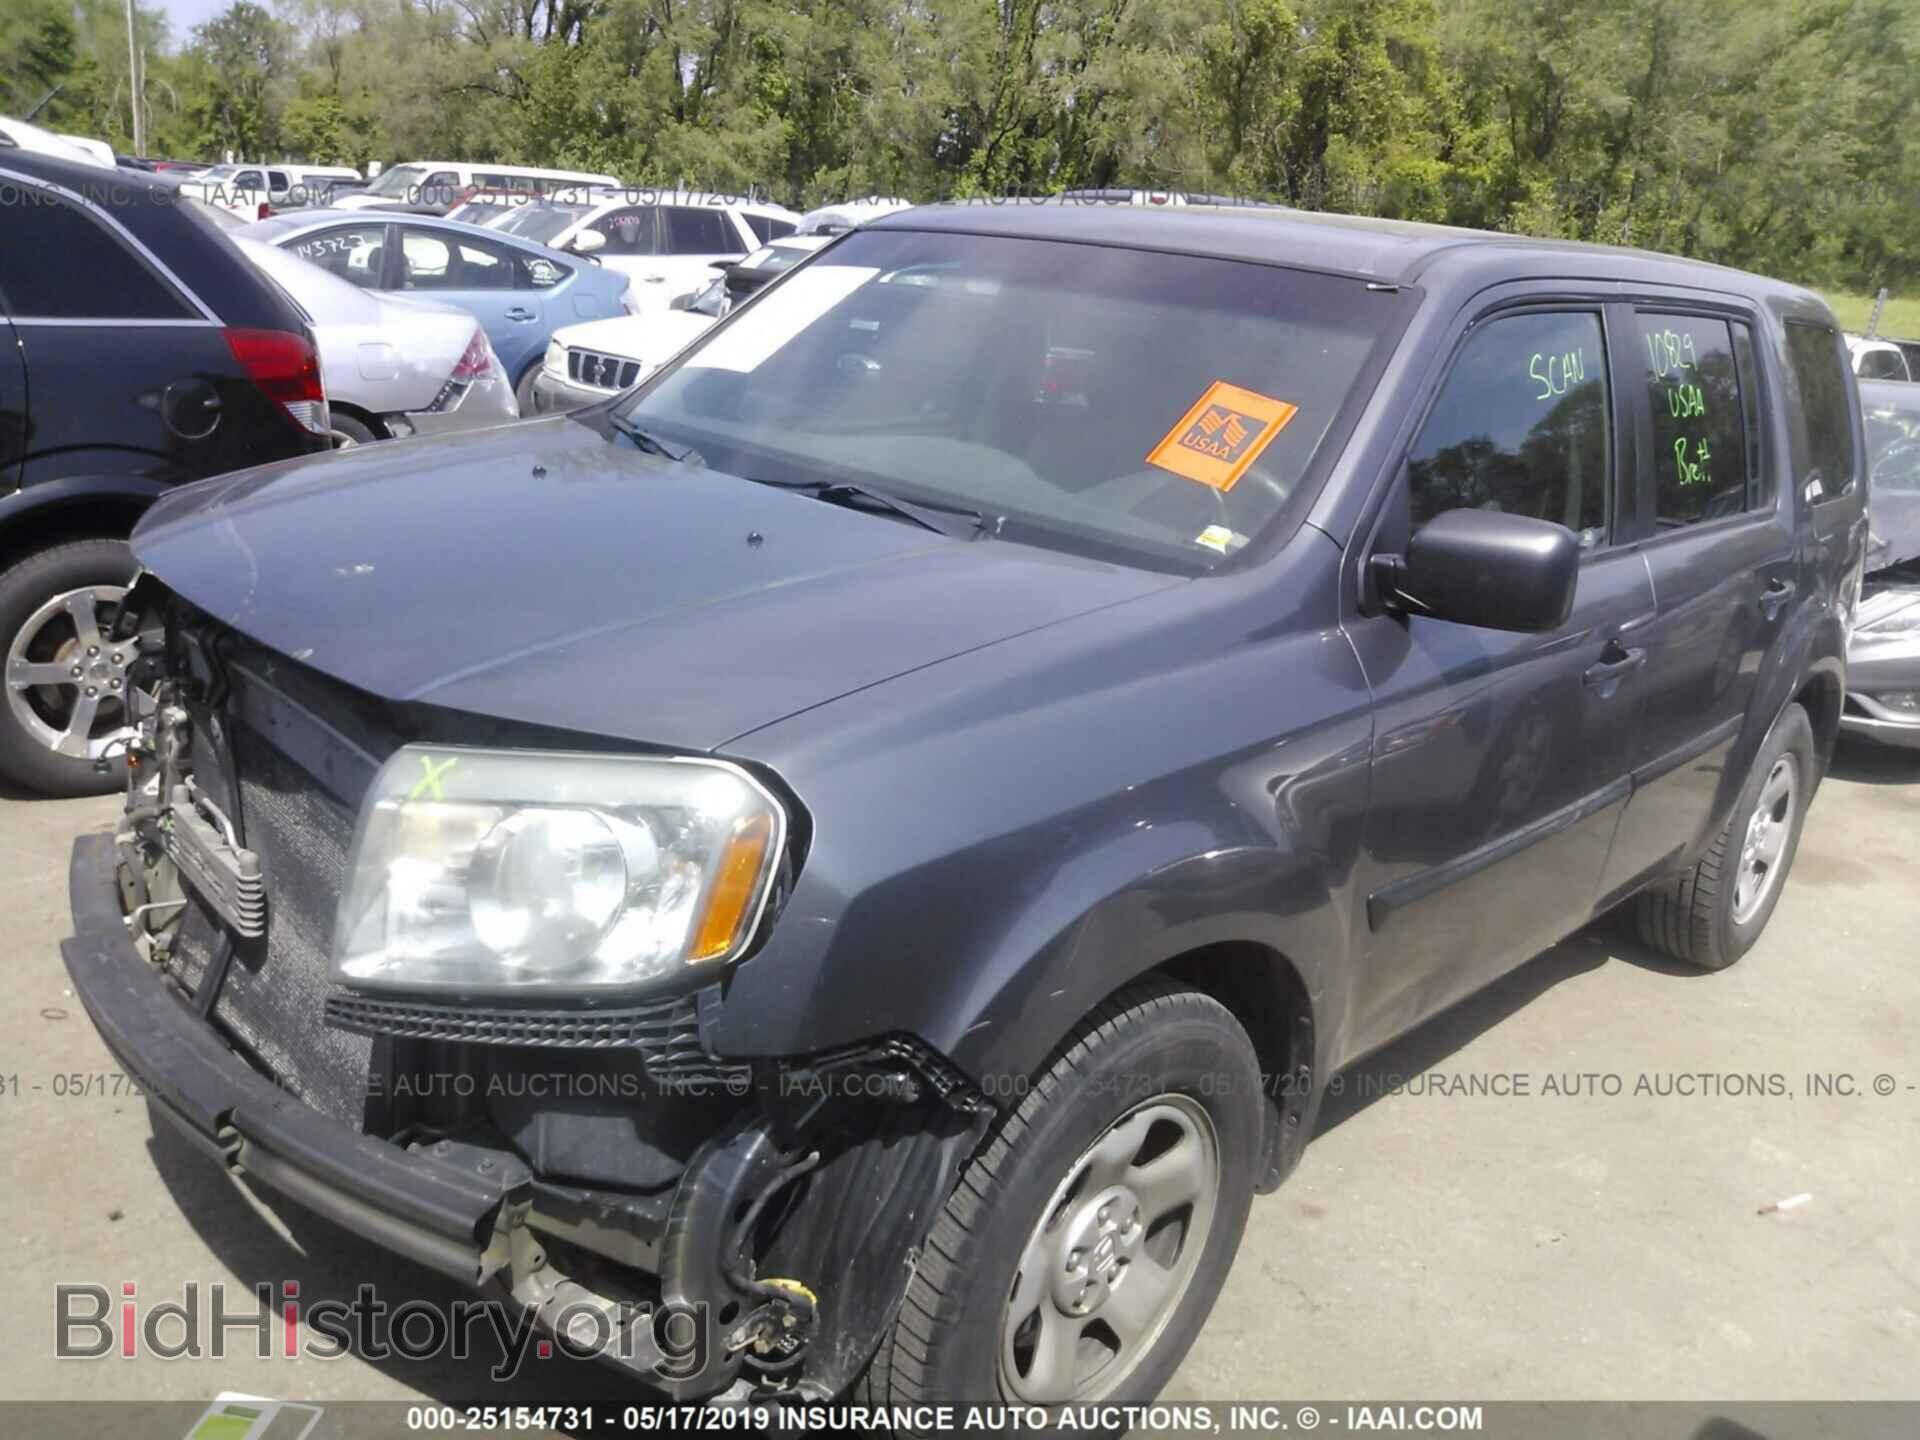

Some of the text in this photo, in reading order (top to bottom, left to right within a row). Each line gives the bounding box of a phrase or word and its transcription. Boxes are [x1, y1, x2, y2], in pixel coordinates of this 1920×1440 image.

[1529, 348, 1584, 400] SCAN
[1646, 329, 1699, 382] 10829
[1668, 383, 1705, 417] USAA
[1183, 432, 1231, 459] USAA
